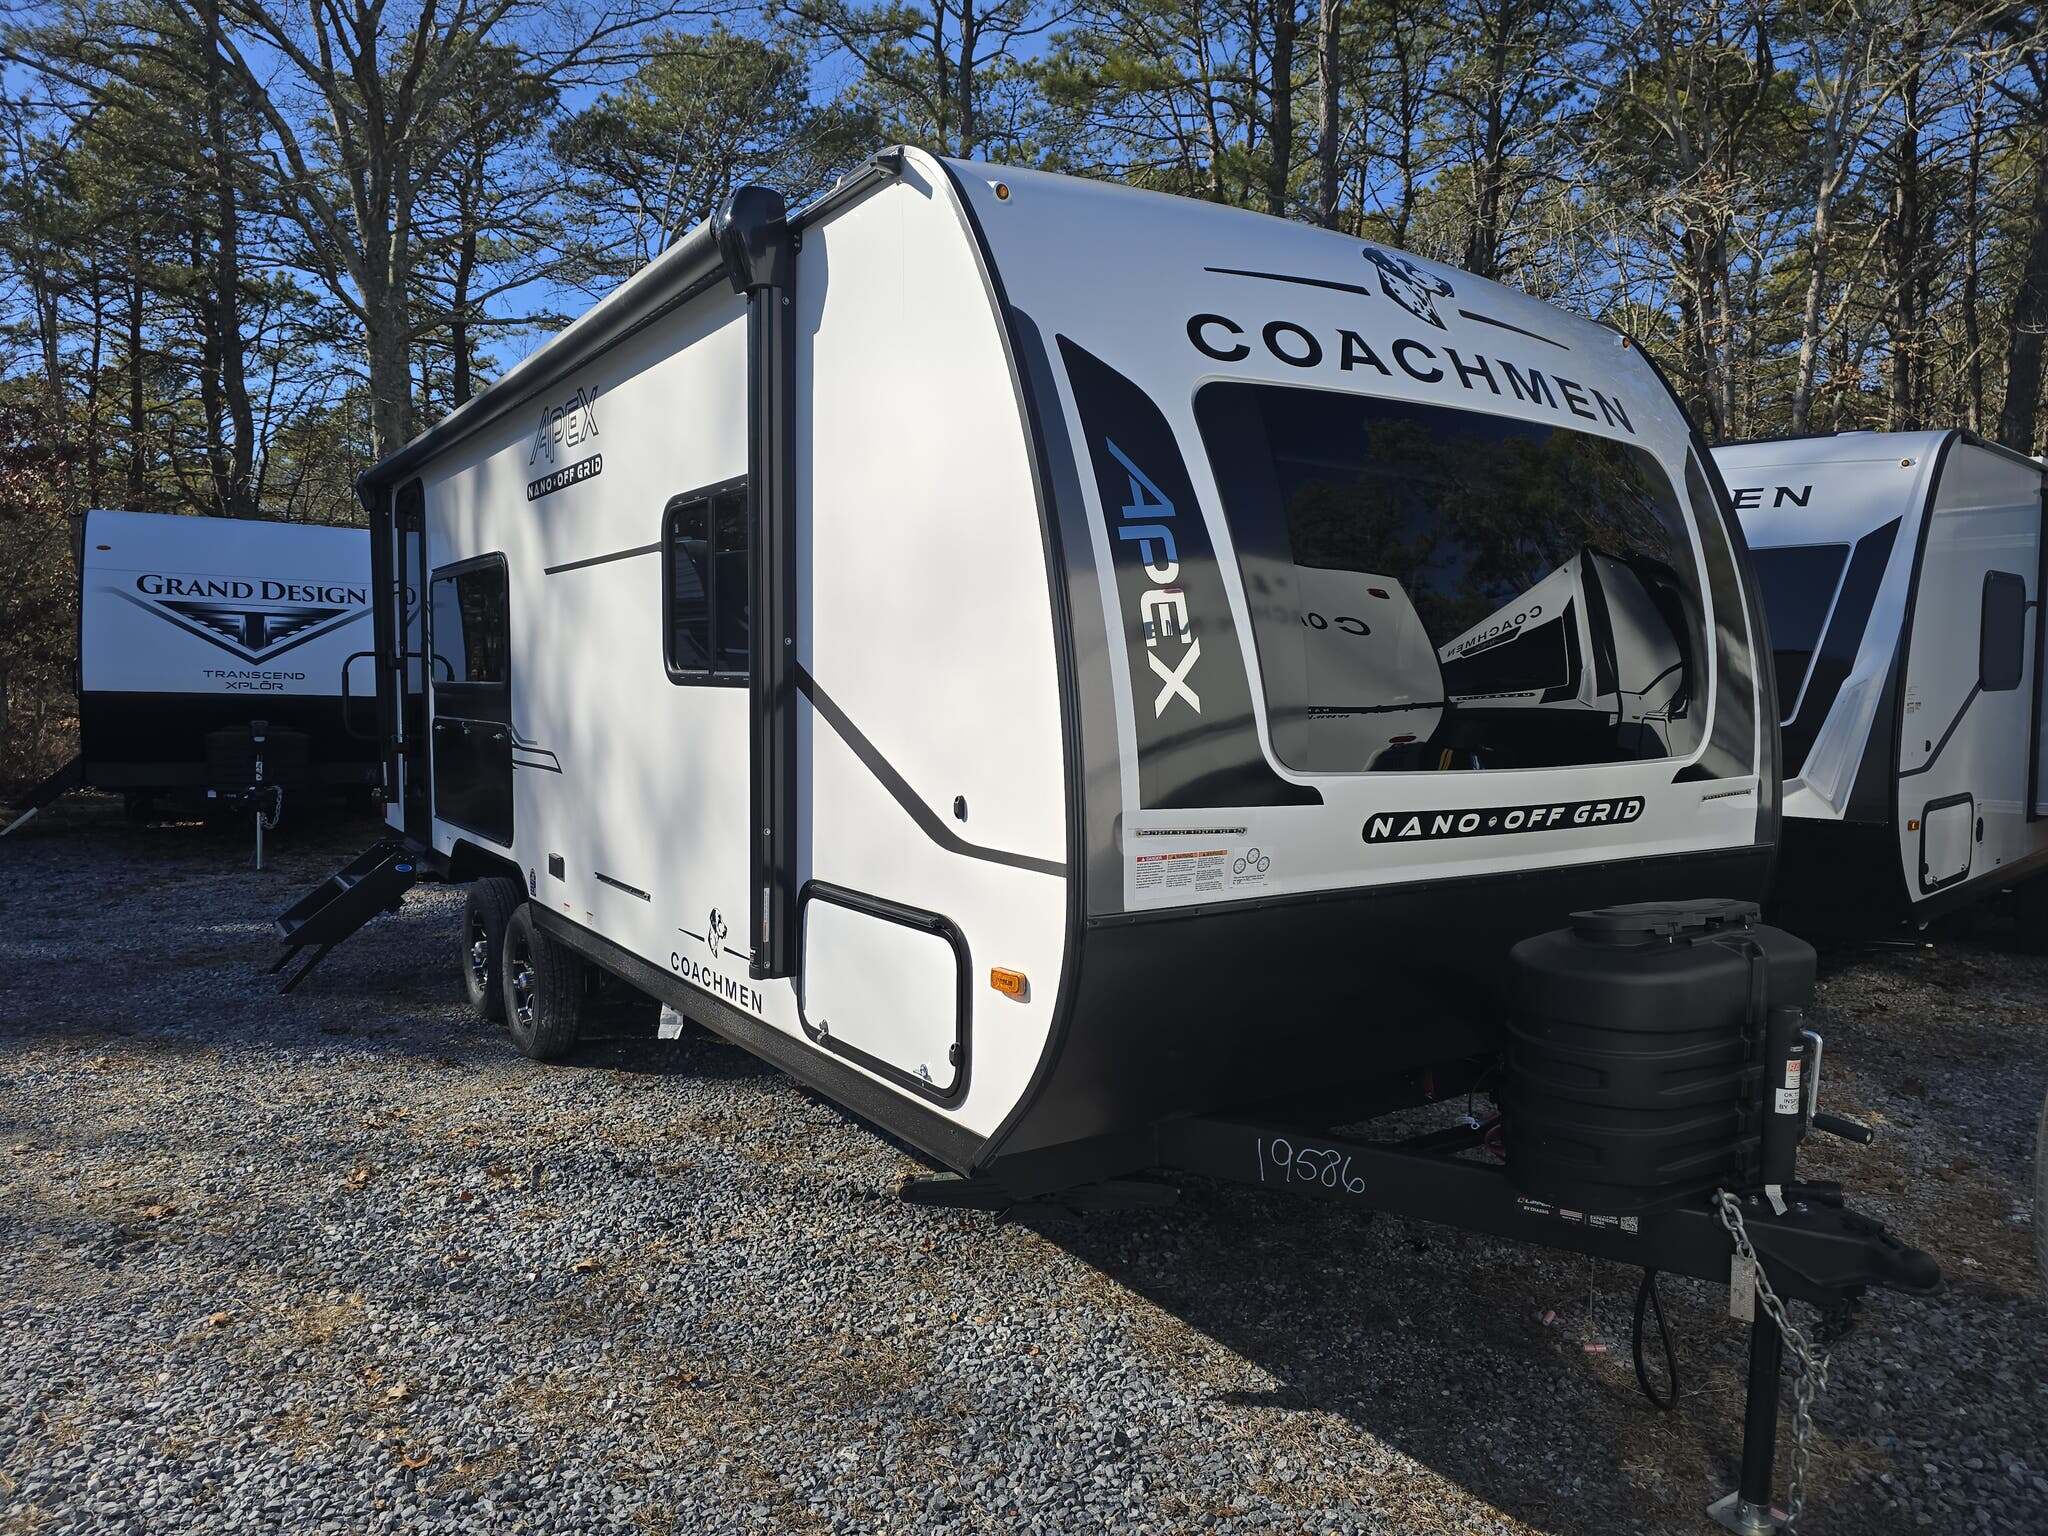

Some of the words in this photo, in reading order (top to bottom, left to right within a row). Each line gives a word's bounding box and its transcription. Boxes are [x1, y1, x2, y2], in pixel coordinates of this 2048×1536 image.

[1187, 313, 1635, 434] COACHMEN
[529, 384, 600, 466] APEX
[527, 478, 552, 499] NANO
[576, 457, 602, 480] GRID
[136, 574, 253, 599] GRAND
[260, 581, 368, 605] DESIGN
[1105, 436, 1201, 719] APEX
[203, 670, 306, 680] TRANSCEND
[1370, 813, 1481, 838] NANO
[1504, 807, 1566, 829] OFF
[1573, 800, 1641, 824] GRID
[670, 951, 764, 1015] COACHMEN
[1258, 1138, 1366, 1194] 19586
